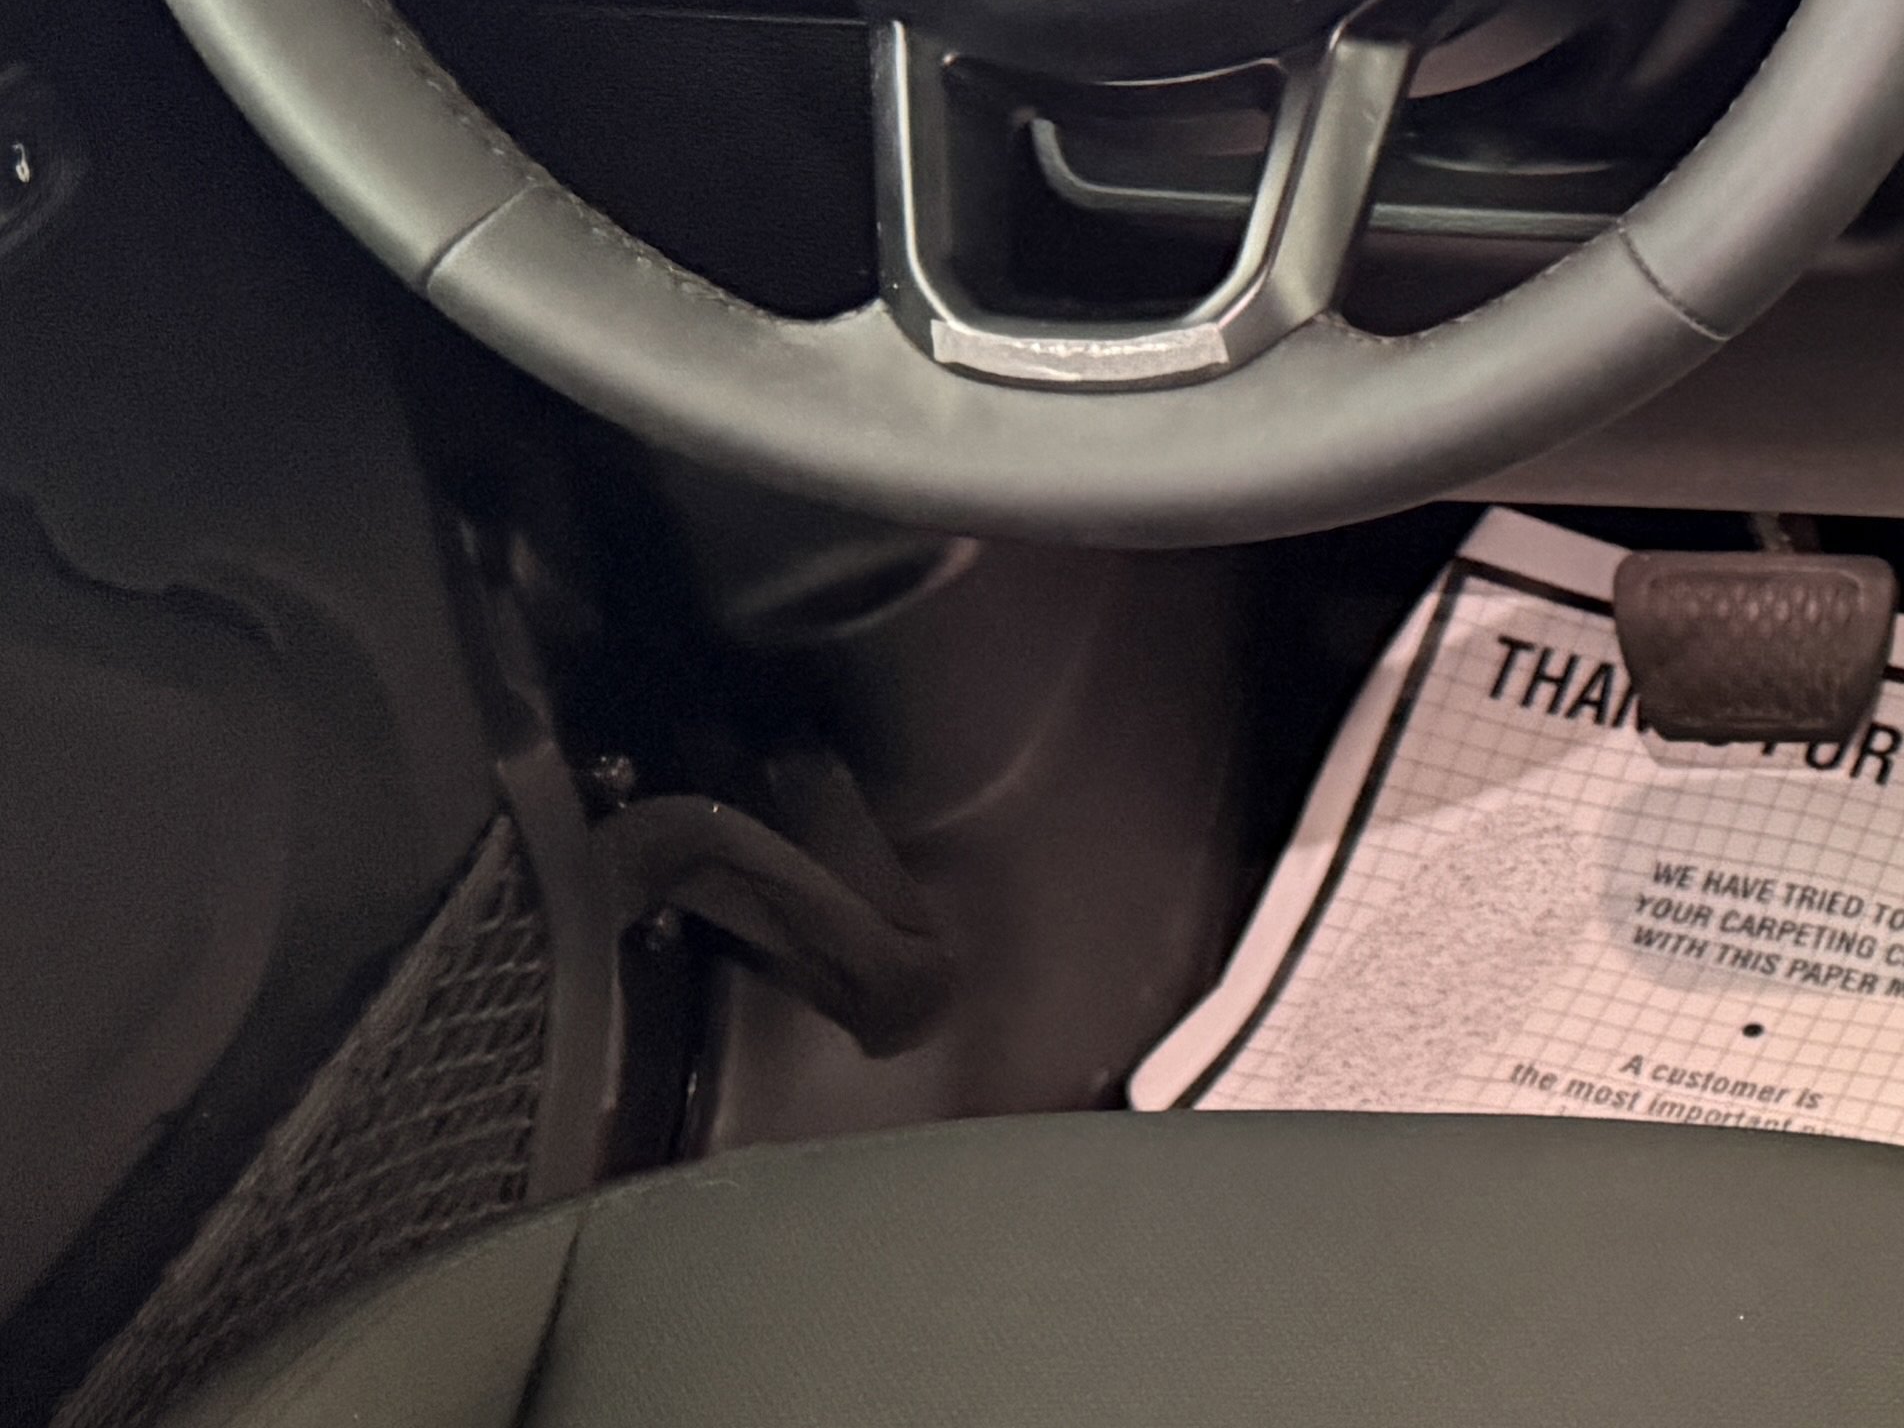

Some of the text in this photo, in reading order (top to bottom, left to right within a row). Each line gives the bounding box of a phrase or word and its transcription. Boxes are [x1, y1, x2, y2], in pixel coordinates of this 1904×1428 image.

[1653, 861, 1697, 889] WE
[1701, 870, 1778, 904] HAVE
[1783, 882, 1864, 918] TRIED
[1635, 893, 1714, 925] YOUR
[1719, 909, 1878, 959] CARPETING
[1633, 925, 1710, 959] WITH
[1714, 942, 1782, 975] THIS
[1786, 958, 1879, 995] PAPER
[1508, 1061, 1558, 1091] the
[1564, 1075, 1642, 1111] most
[1619, 1054, 1824, 1110] A customer is
